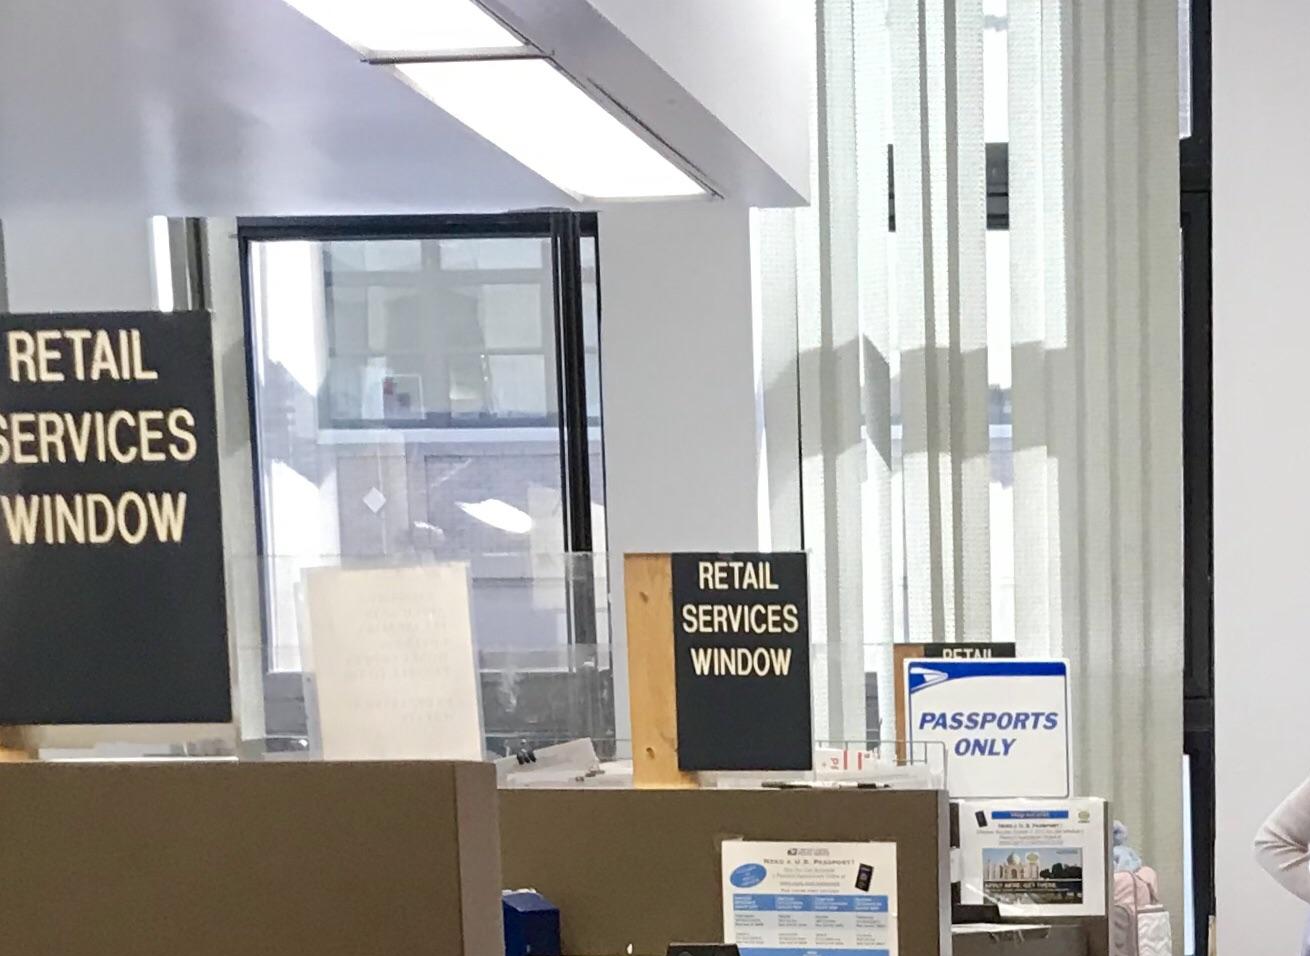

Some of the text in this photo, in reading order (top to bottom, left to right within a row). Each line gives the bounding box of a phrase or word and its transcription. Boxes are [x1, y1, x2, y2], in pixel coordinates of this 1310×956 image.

[8, 328, 158, 382] RETAIL
[0, 491, 187, 545] WINDOW
[698, 561, 779, 590] RETAIL
[682, 604, 799, 634] SERVICES
[690, 647, 792, 676] WINDOW
[919, 711, 1059, 731] PASSPORTS
[954, 738, 1016, 756] ONLY
